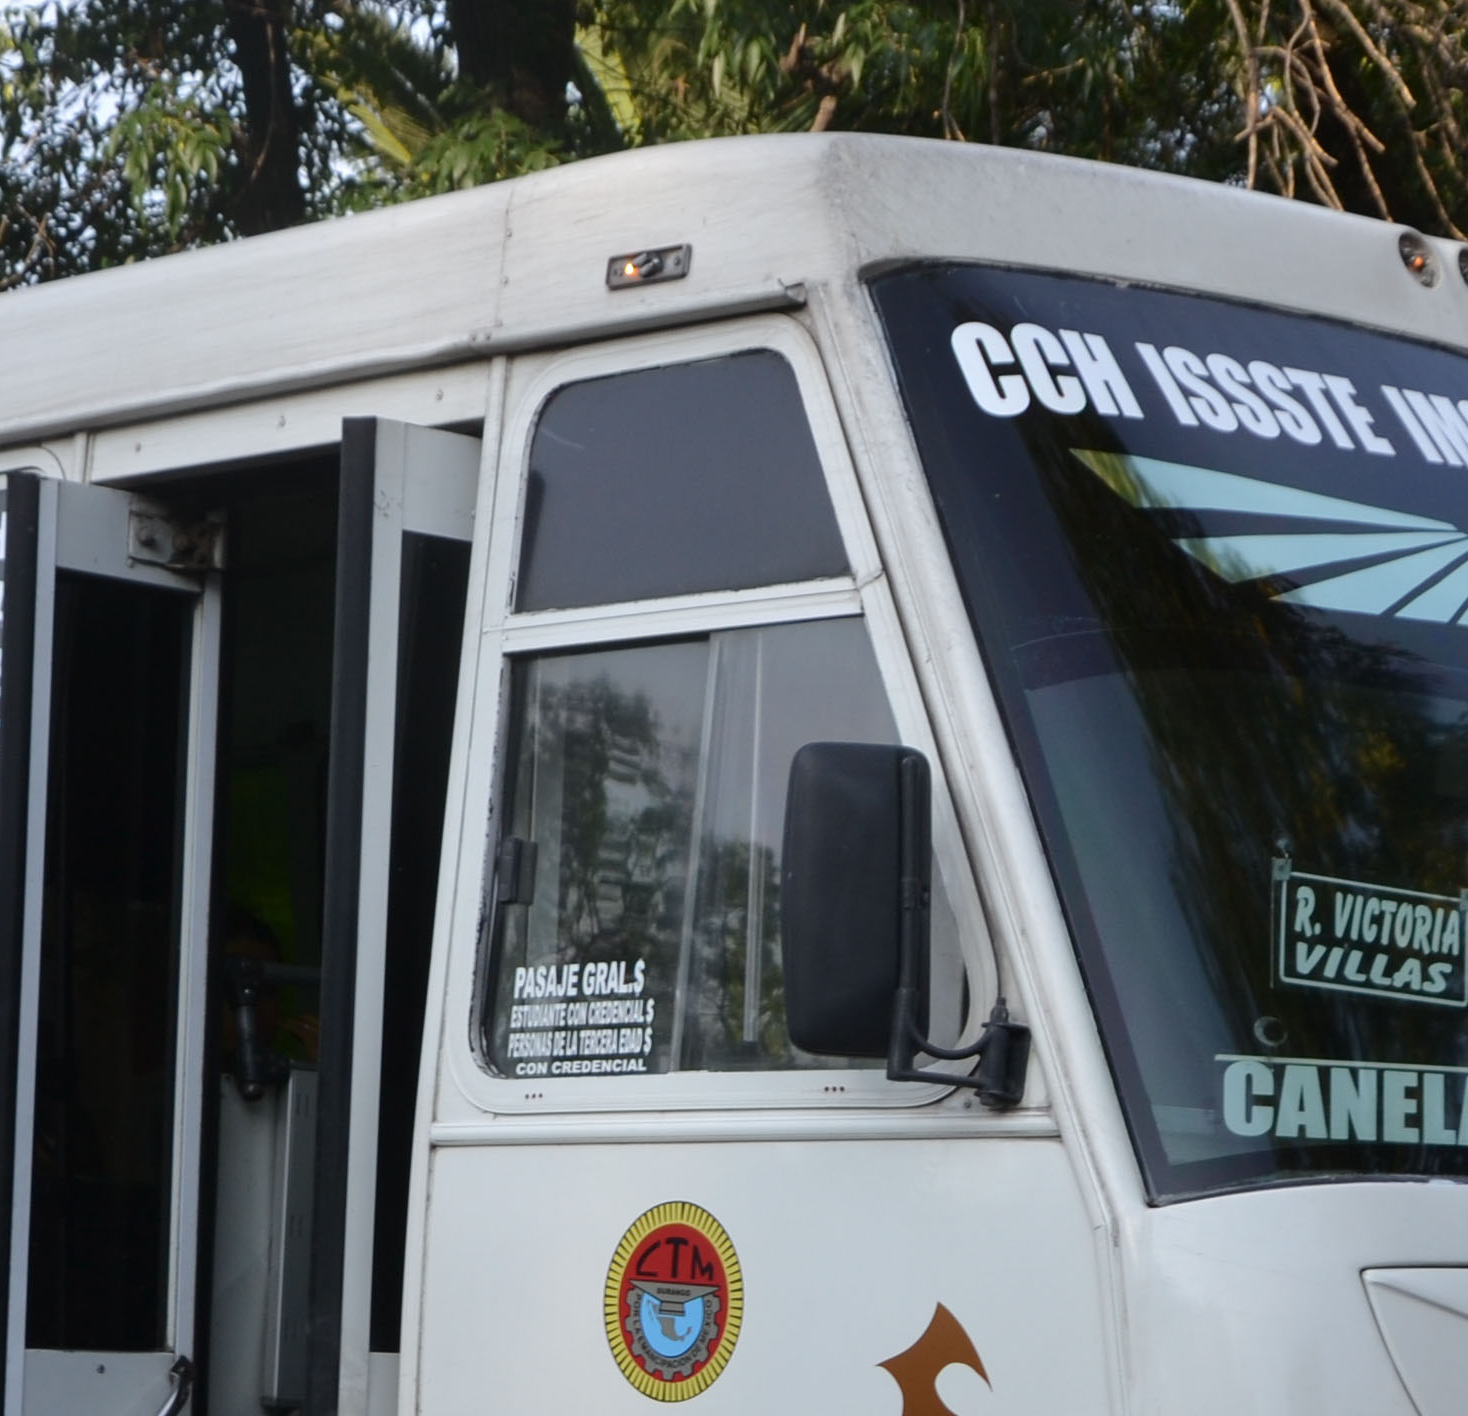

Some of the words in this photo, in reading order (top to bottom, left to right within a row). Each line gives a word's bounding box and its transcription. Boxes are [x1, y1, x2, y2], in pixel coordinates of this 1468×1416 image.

[950, 321, 1144, 418] CCH
[1135, 341, 1395, 456] ISSSTE
[1294, 886, 1321, 937] R.
[1334, 891, 1460, 956] VICTORIA
[513, 964, 580, 999] PASAJE
[1295, 942, 1453, 993] VILLAS
[510, 1003, 567, 1028] ESTUDIANTE
[567, 1002, 588, 1026] CON
[588, 1000, 645, 1024] CREDENCIAL
[645, 998, 655, 1024] $
[507, 1031, 553, 1058] PERSONAS
[552, 1031, 566, 1057] DE
[565, 1030, 579, 1056] LA
[579, 1029, 618, 1055] TERCERA
[618, 1028, 643, 1054] EDAD
[643, 1026, 653, 1056] $
[515, 1063, 548, 1076] CON
[551, 1058, 648, 1075] CREDENCIAL
[635, 1236, 714, 1281] CTM
